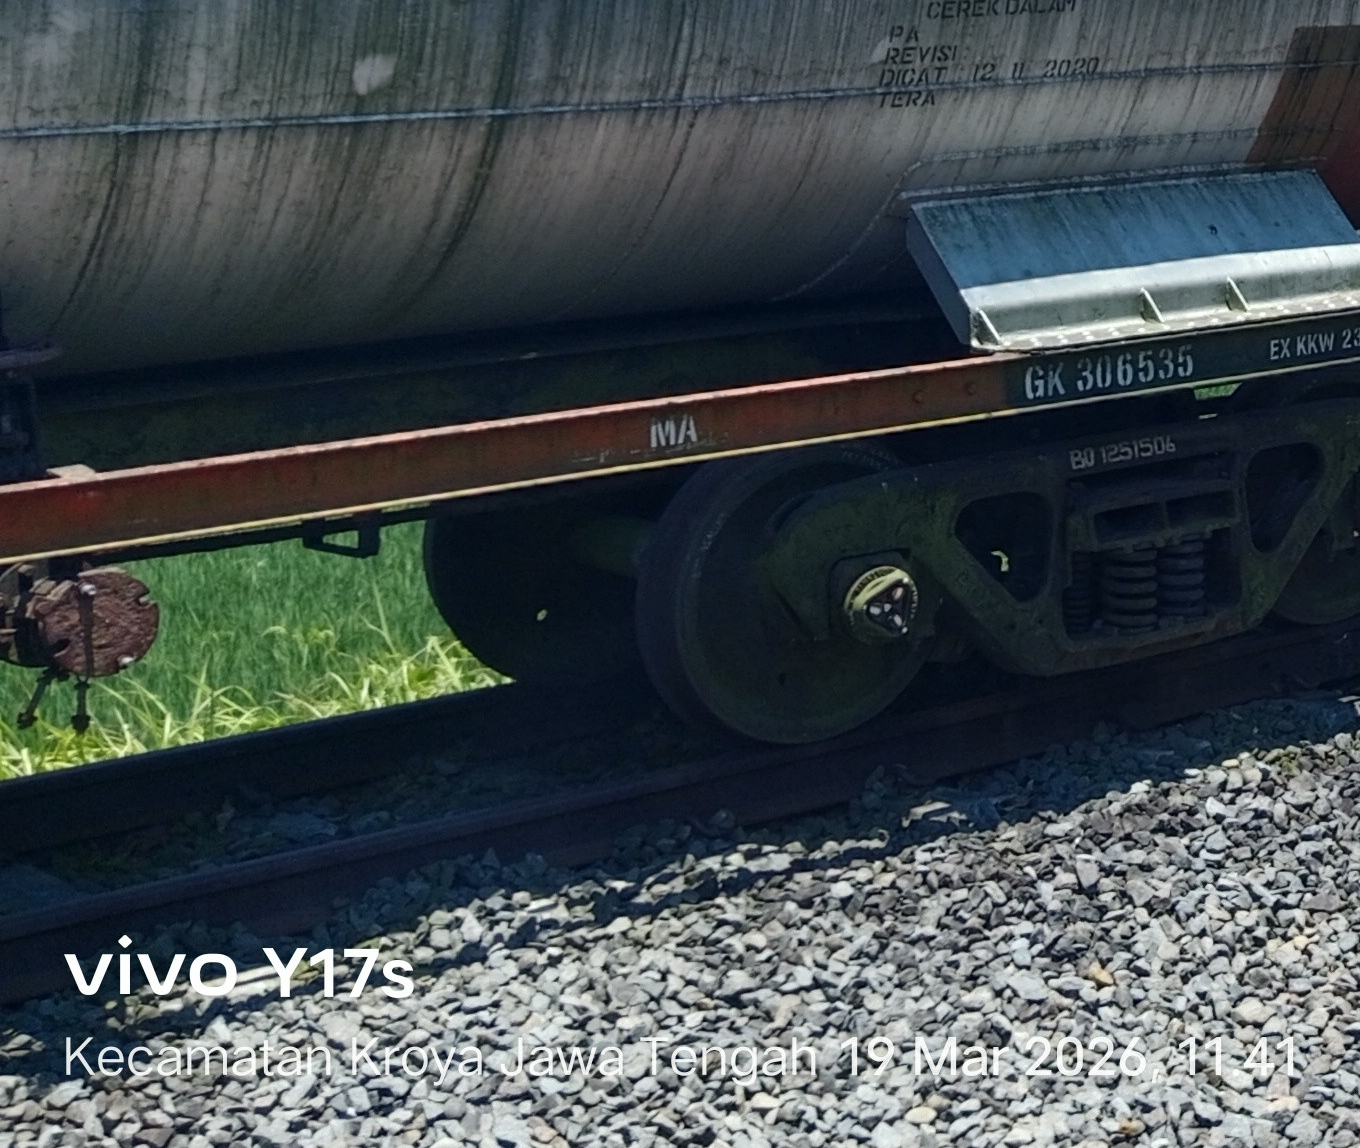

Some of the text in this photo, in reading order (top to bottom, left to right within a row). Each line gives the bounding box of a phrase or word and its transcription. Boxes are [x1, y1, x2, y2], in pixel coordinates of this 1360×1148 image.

[973, 62, 996, 82] 12
[1043, 56, 1100, 78] 2020
[880, 90, 936, 108] TERA
[1269, 337, 1291, 361] EX
[1296, 332, 1334, 357] KKW
[1024, 345, 1195, 400] GK 306535
[651, 414, 698, 447] MA
